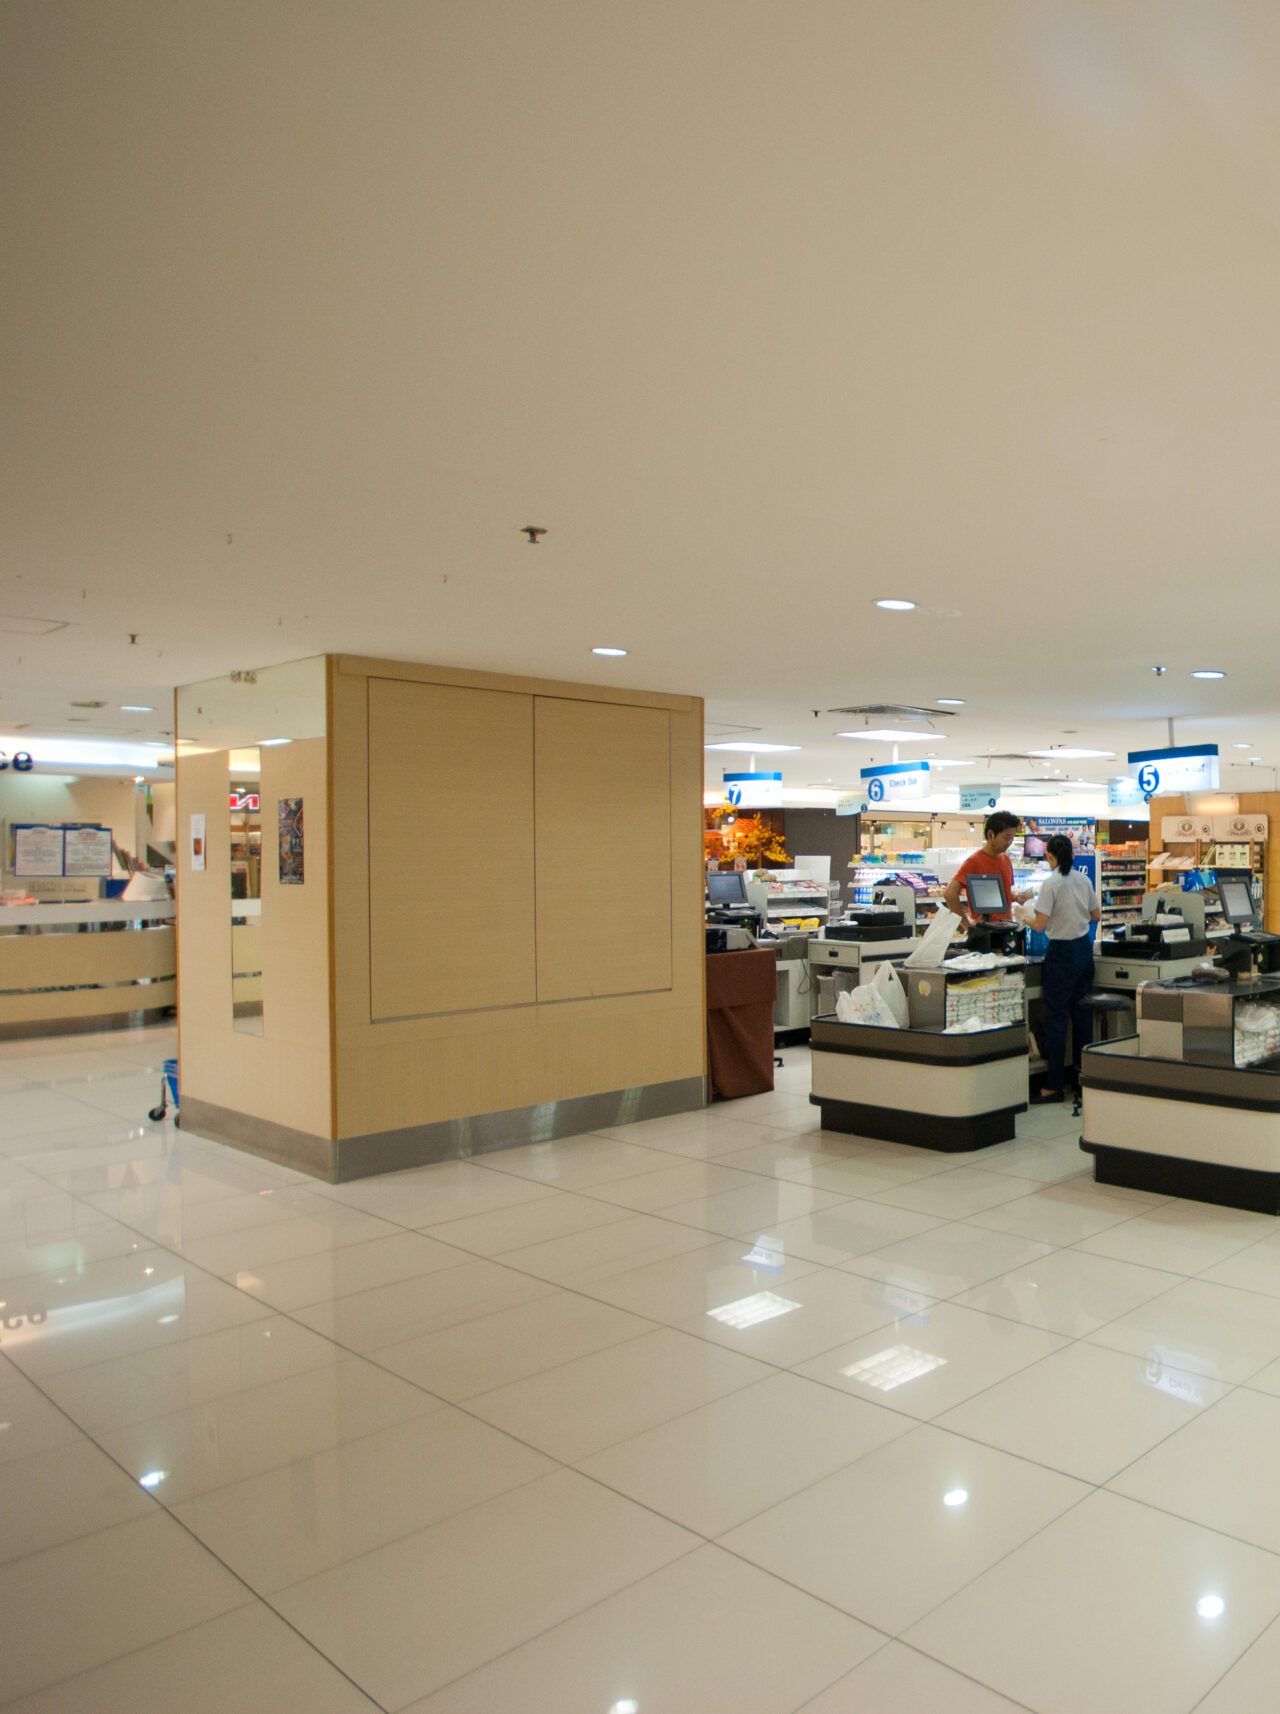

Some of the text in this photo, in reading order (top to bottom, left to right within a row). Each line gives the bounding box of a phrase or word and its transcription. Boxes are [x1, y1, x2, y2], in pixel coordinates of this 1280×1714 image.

[869, 779, 881, 799] 6
[889, 777, 917, 788] Check Out
[1142, 766, 1156, 792] 5
[730, 785, 741, 805] 7
